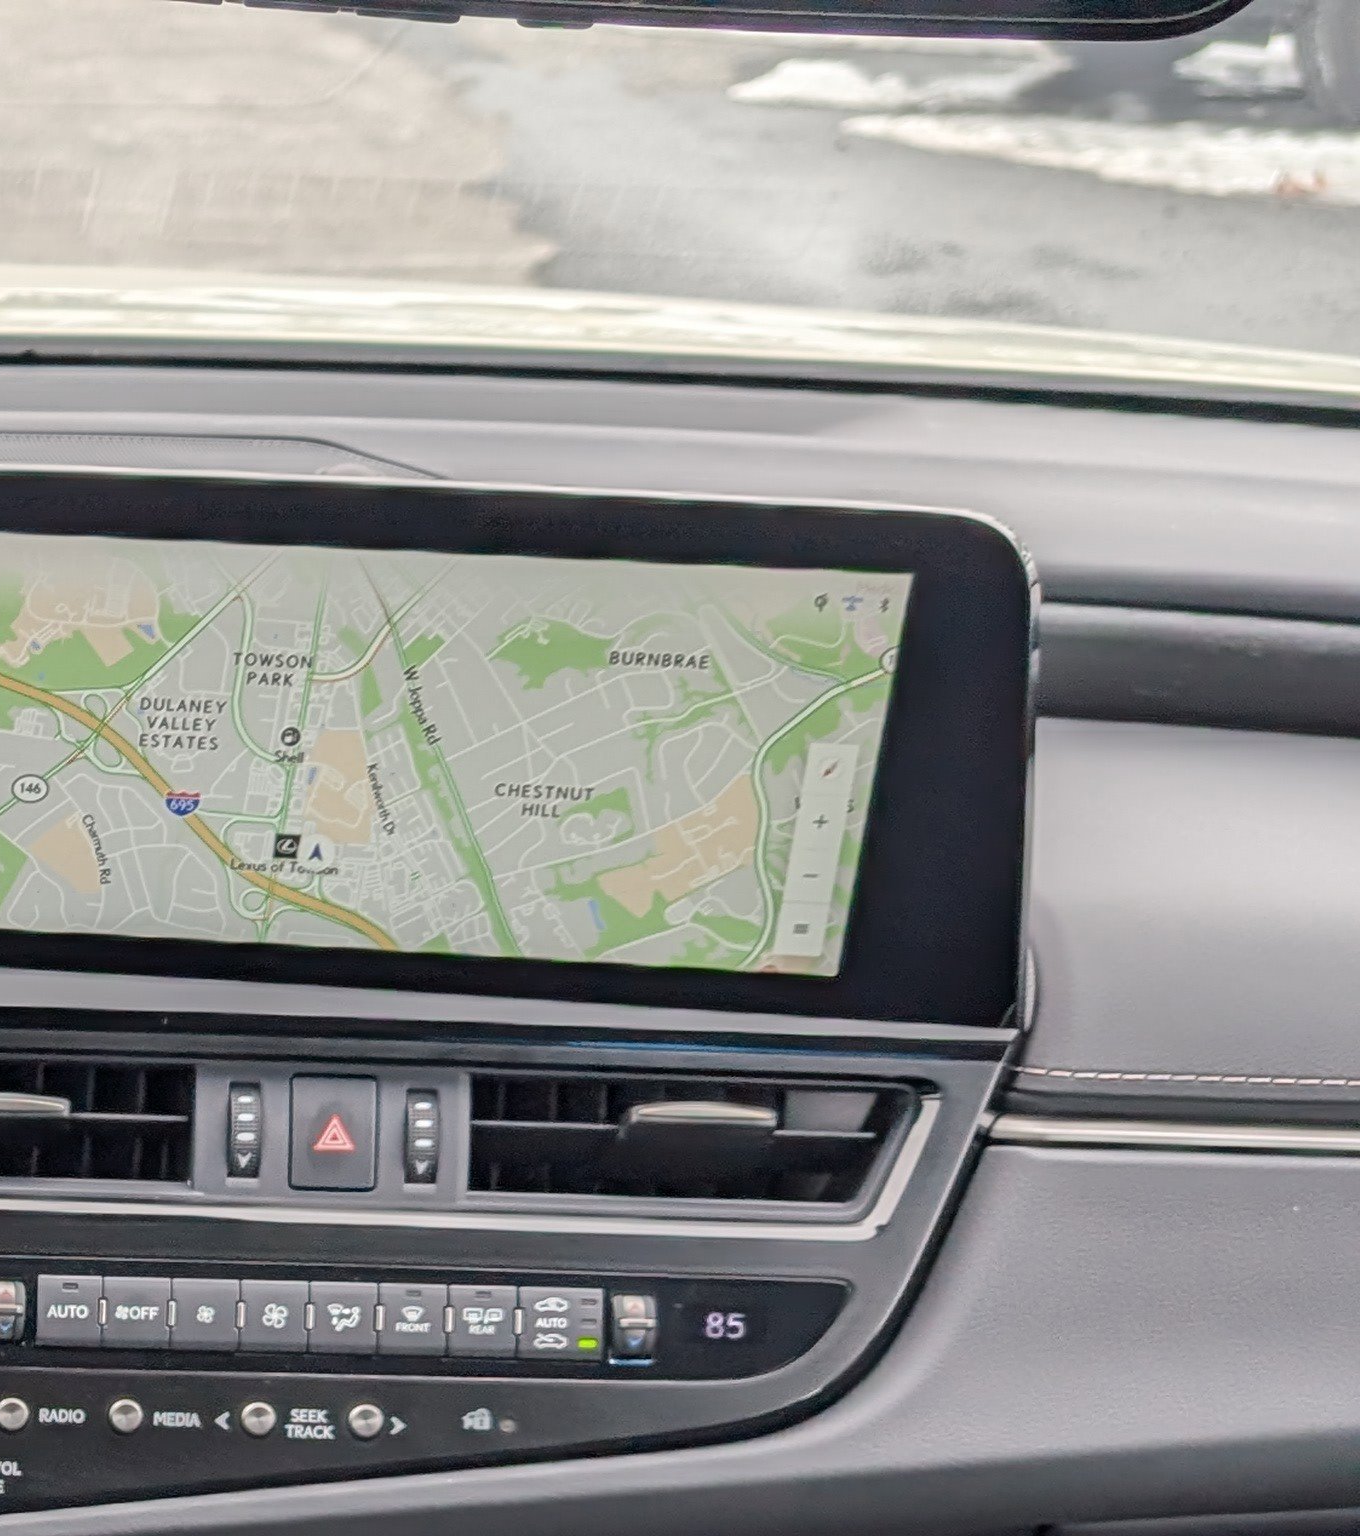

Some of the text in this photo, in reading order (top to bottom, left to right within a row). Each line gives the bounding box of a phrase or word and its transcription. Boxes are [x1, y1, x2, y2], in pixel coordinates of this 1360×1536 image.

[234, 652, 314, 669] TOWSON
[608, 650, 710, 670] BURNBRAE
[246, 672, 295, 688] PARK
[139, 697, 228, 714] DULANEY
[403, 665, 442, 746] W Joppa Rd
[146, 716, 217, 732] VALLEY
[138, 733, 219, 751] ESTATES
[274, 751, 305, 764] Shell
[20, 782, 42, 795] 146
[494, 782, 595, 801] CHESTNUT
[169, 800, 195, 812] 695
[520, 803, 561, 818] HILL
[230, 857, 267, 872] Lexus
[270, 862, 286, 873] of
[99, 867, 112, 885] Rd
[46, 1304, 89, 1319] AUTO
[129, 1305, 160, 1320] OFF
[395, 1322, 431, 1334] FRONT
[468, 1324, 496, 1335] REAR
[535, 1317, 569, 1329] AUTO
[705, 1311, 747, 1340] 85
[39, 1407, 86, 1425] RADIO
[152, 1411, 201, 1428] MEDIA
[290, 1408, 329, 1423] SEEK
[284, 1424, 336, 1440] TRACK
